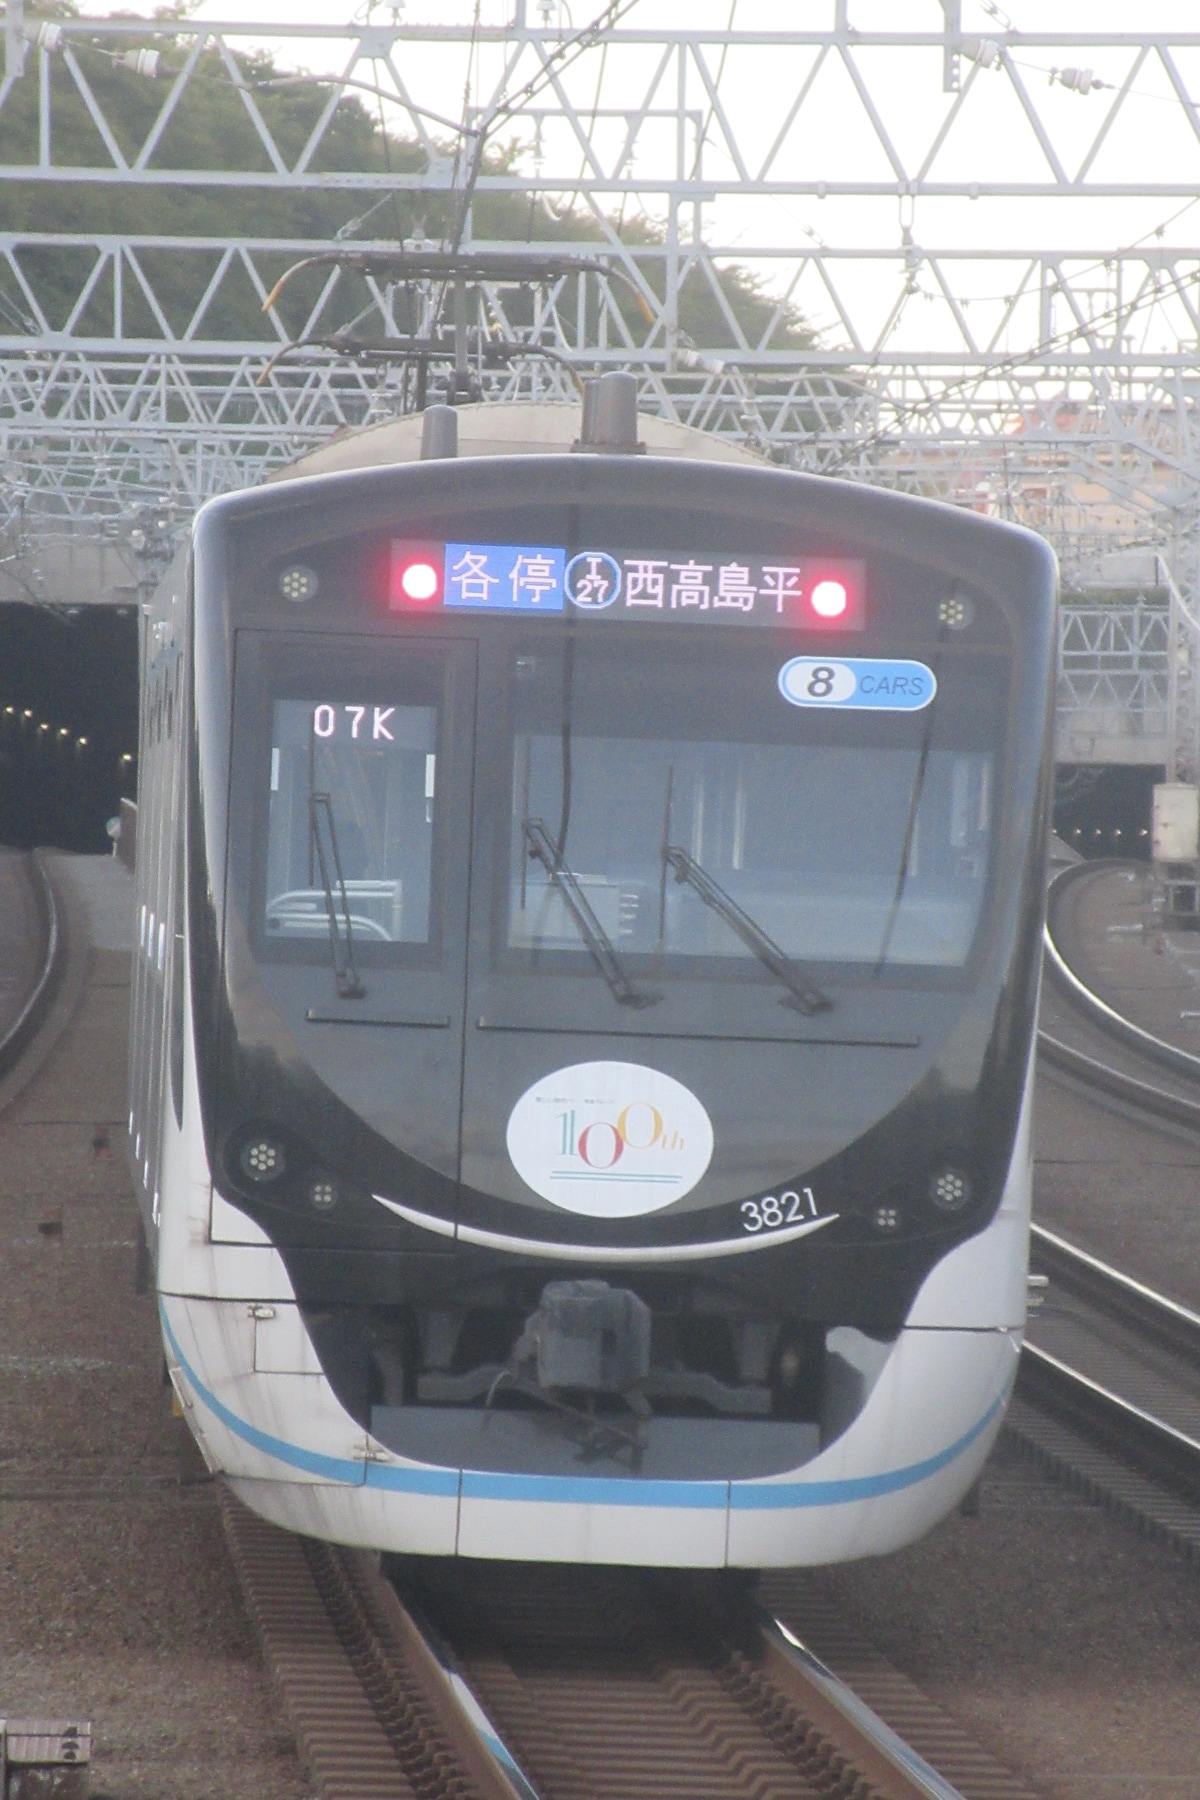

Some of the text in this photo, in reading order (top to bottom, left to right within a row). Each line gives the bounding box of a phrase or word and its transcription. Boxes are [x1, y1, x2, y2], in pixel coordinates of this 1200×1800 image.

[450, 551, 558, 603] 各停
[576, 580, 608, 603] 27
[624, 559, 802, 612] 西高島平
[807, 666, 924, 697] 8 CARS
[314, 704, 395, 740] 07K
[741, 1187, 817, 1232] 3821
